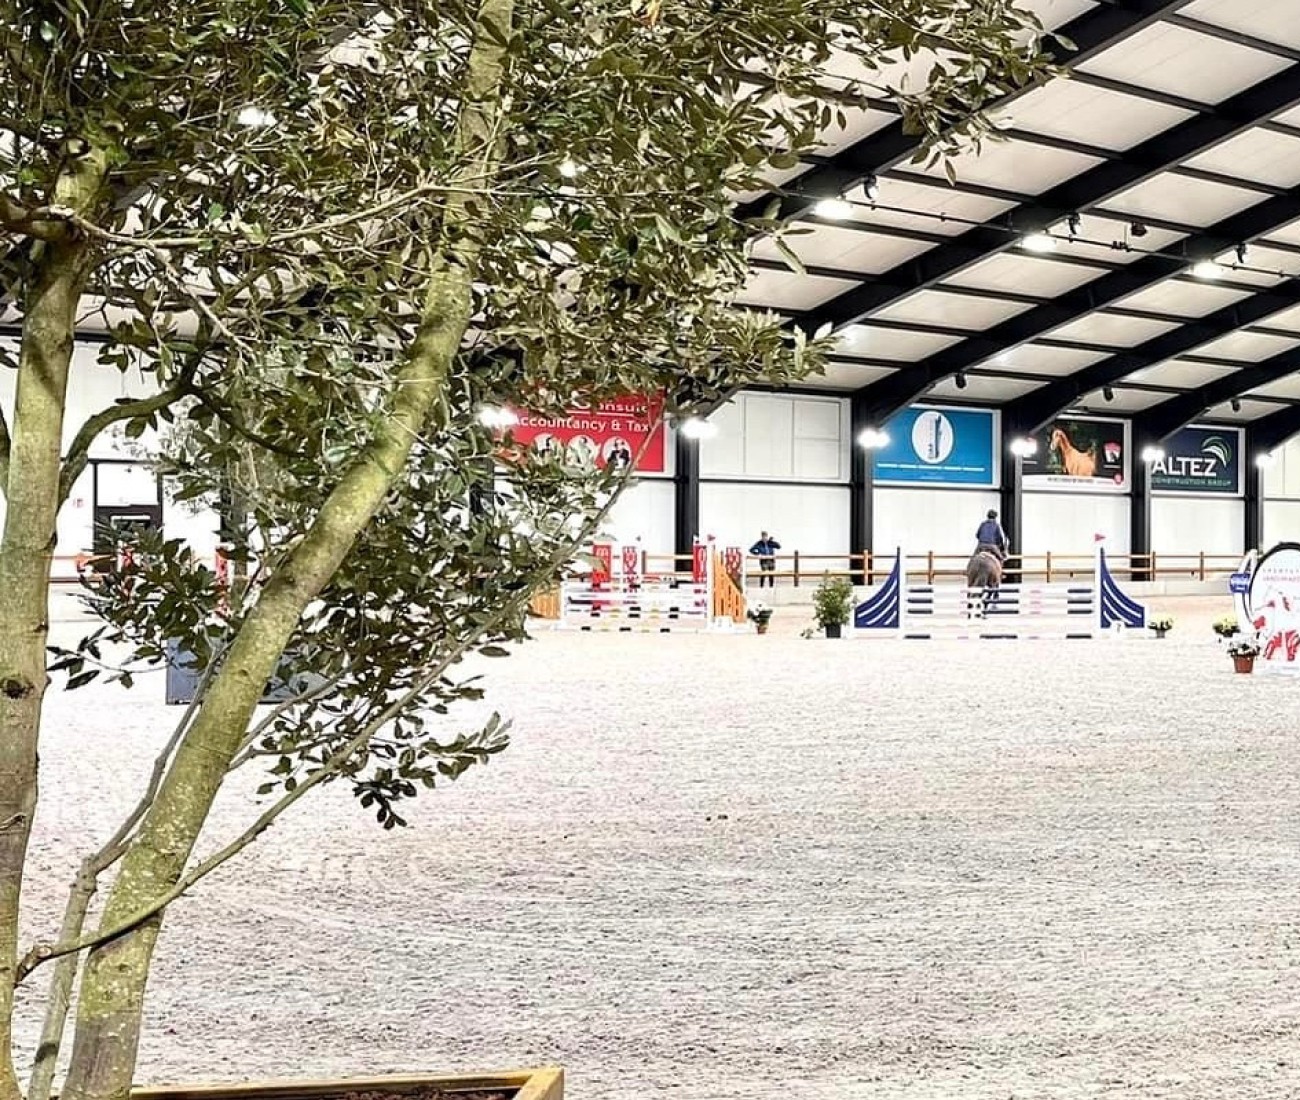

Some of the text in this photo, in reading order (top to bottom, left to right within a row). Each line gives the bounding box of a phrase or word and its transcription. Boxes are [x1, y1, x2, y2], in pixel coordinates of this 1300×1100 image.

[511, 415, 649, 433] ccountancy & Tax
[1152, 456, 1217, 477] ALTEZ
